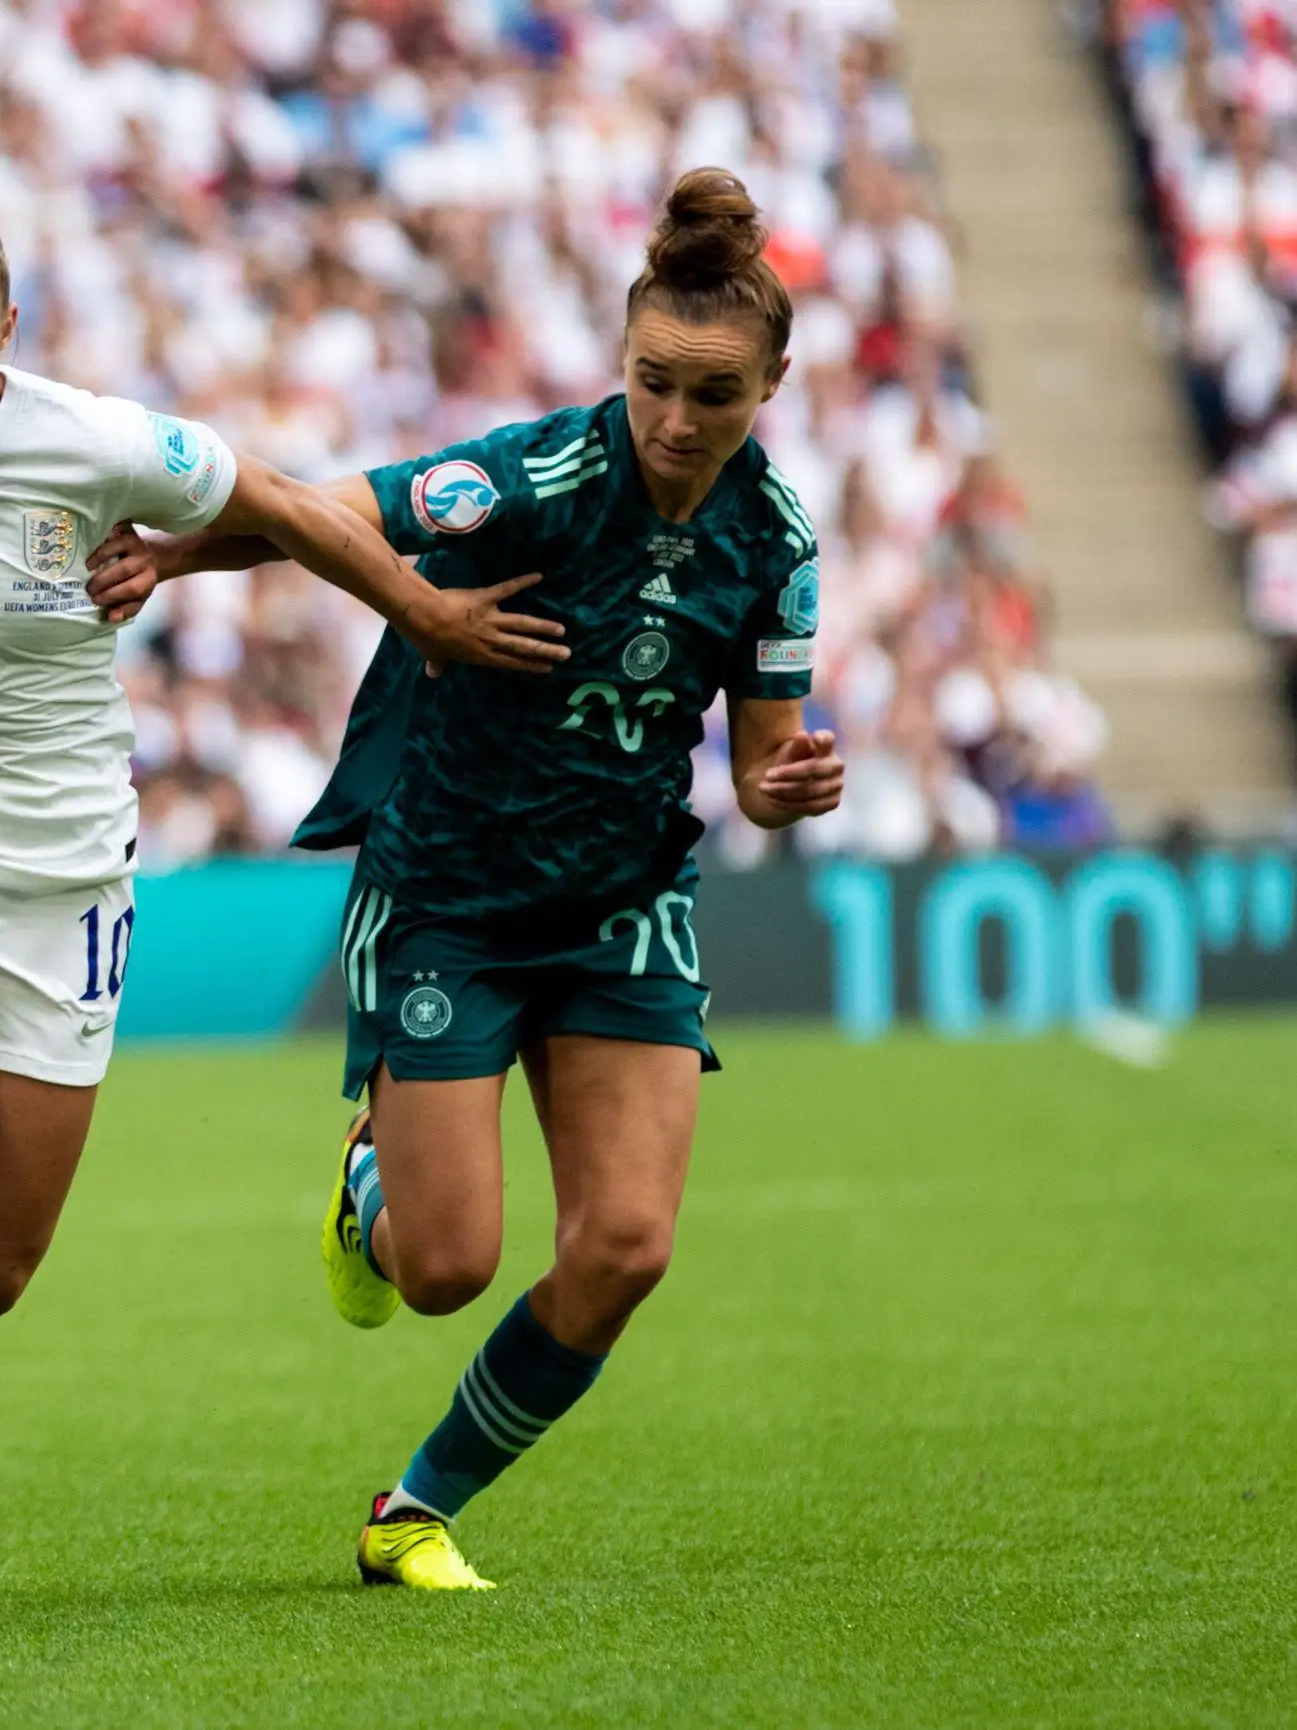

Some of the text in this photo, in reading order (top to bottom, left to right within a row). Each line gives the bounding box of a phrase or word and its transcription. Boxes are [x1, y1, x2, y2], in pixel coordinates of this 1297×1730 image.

[12, 581, 51, 591] ENGLAND
[42, 591, 60, 602] JULY
[639, 589, 677, 605] adidas
[4, 603, 24, 612] UEFA
[26, 603, 59, 612] WOMENS
[79, 904, 135, 1001] 10
